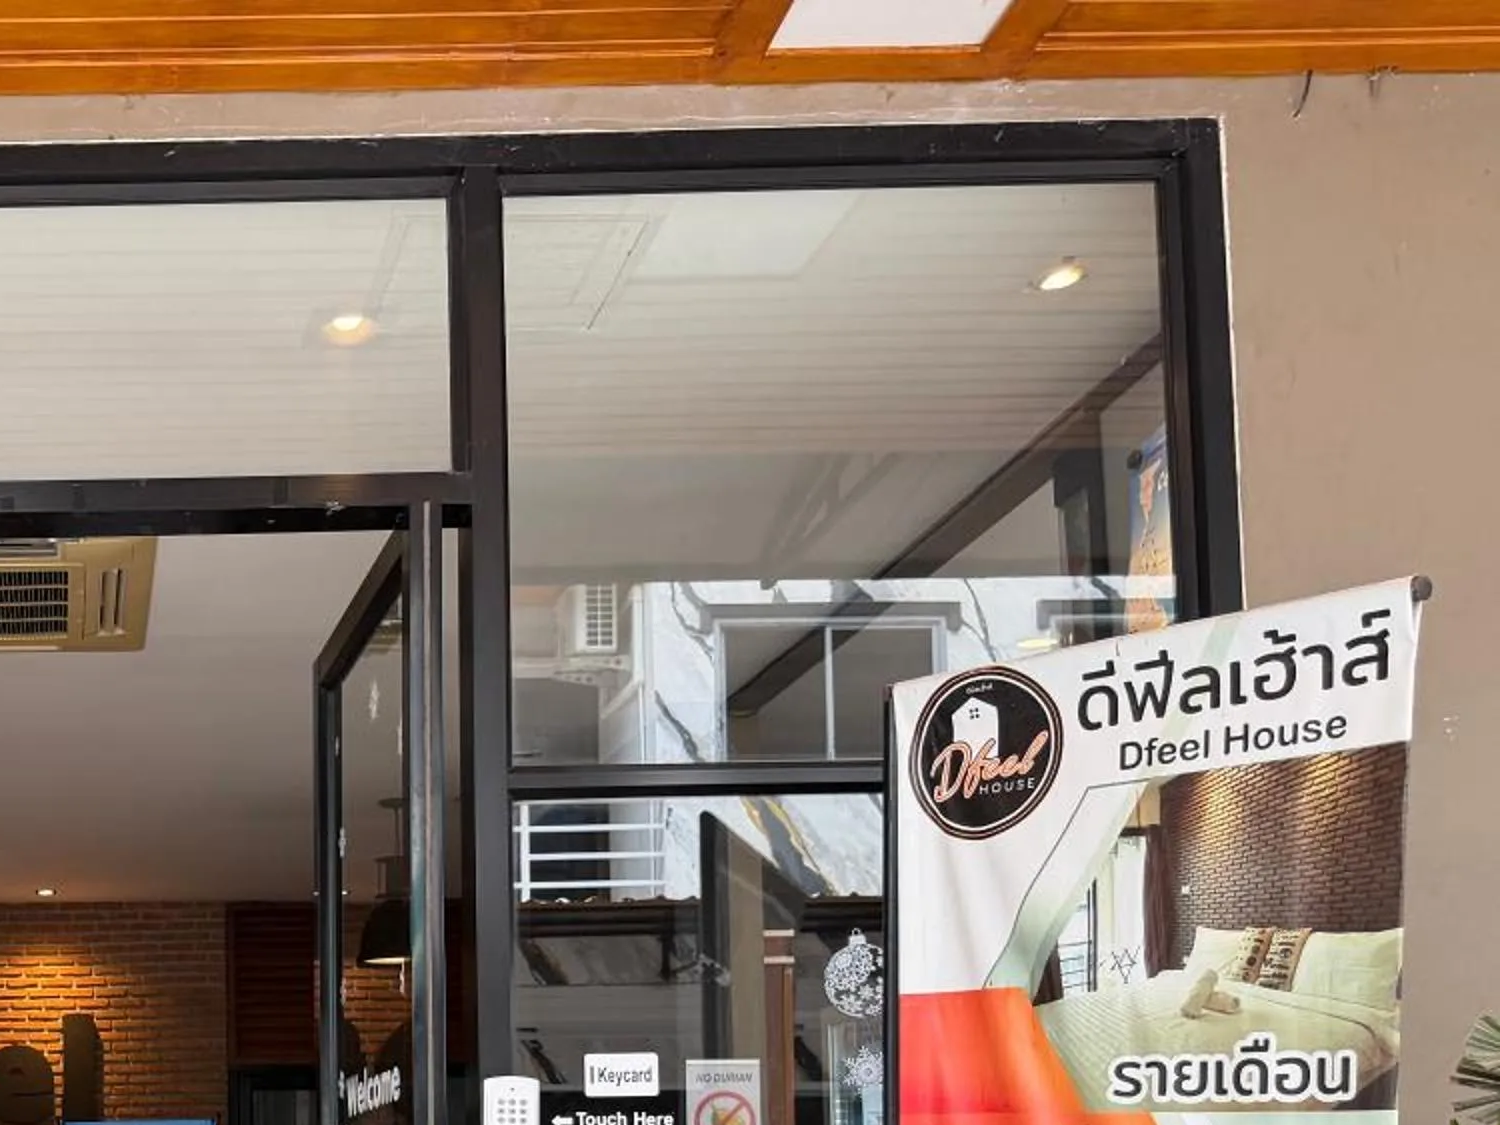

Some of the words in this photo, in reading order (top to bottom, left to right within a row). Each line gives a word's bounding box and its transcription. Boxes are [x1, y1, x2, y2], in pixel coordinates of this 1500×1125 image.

[1077, 608, 1392, 731] ดีฟีลเฮ้าส์
[930, 729, 1050, 804] Dfeel
[1119, 729, 1211, 771] Dfeel
[1224, 714, 1348, 755] House
[978, 777, 1037, 796] HOUSE
[345, 1065, 402, 1118] Welcome
[597, 1066, 654, 1087] Keycard
[1113, 1036, 1353, 1100] รายเดือน
